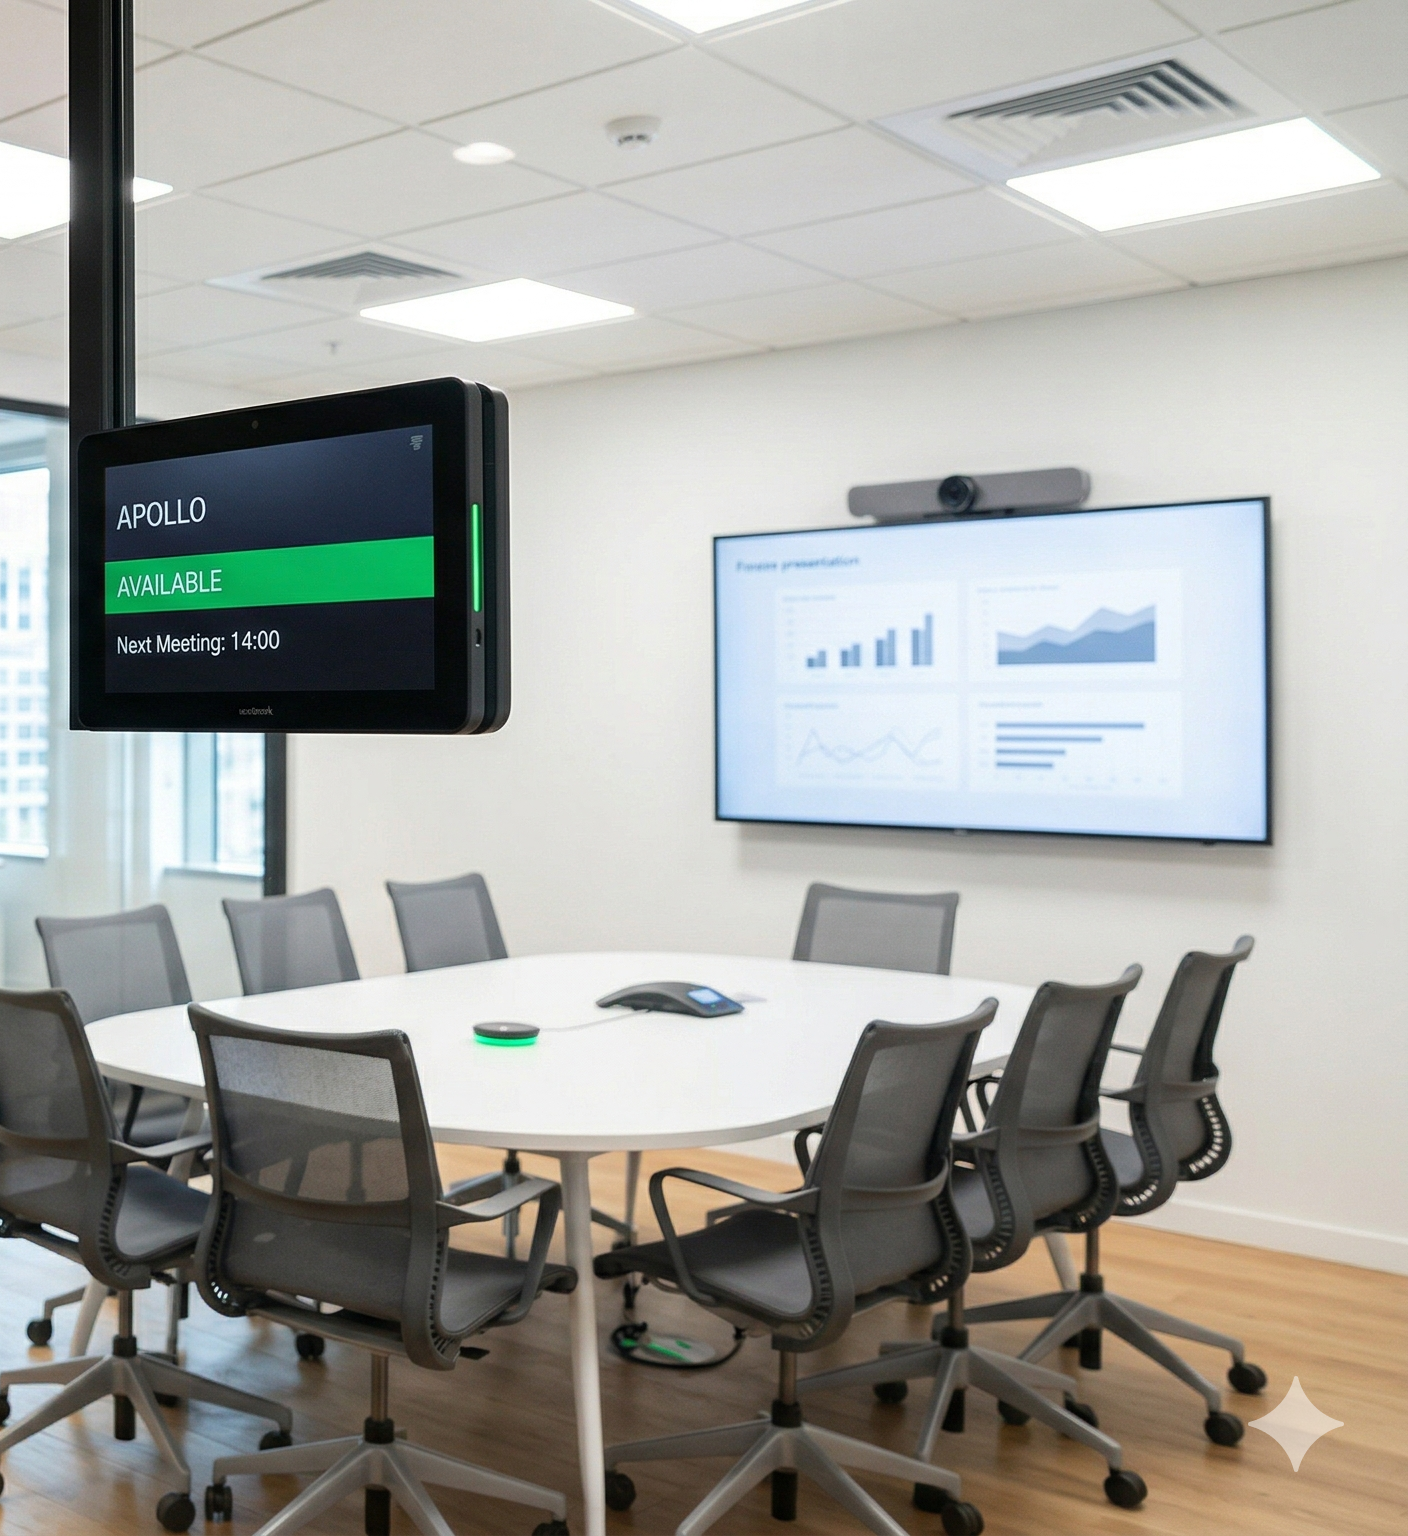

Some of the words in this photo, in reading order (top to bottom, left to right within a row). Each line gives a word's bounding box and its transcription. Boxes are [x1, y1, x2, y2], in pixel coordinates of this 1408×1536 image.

[116, 496, 207, 531] APOLLO
[117, 569, 223, 598] AVAILABLE
[117, 635, 152, 655] Next
[156, 632, 226, 657] Meeting:
[231, 629, 280, 651] 14:00
